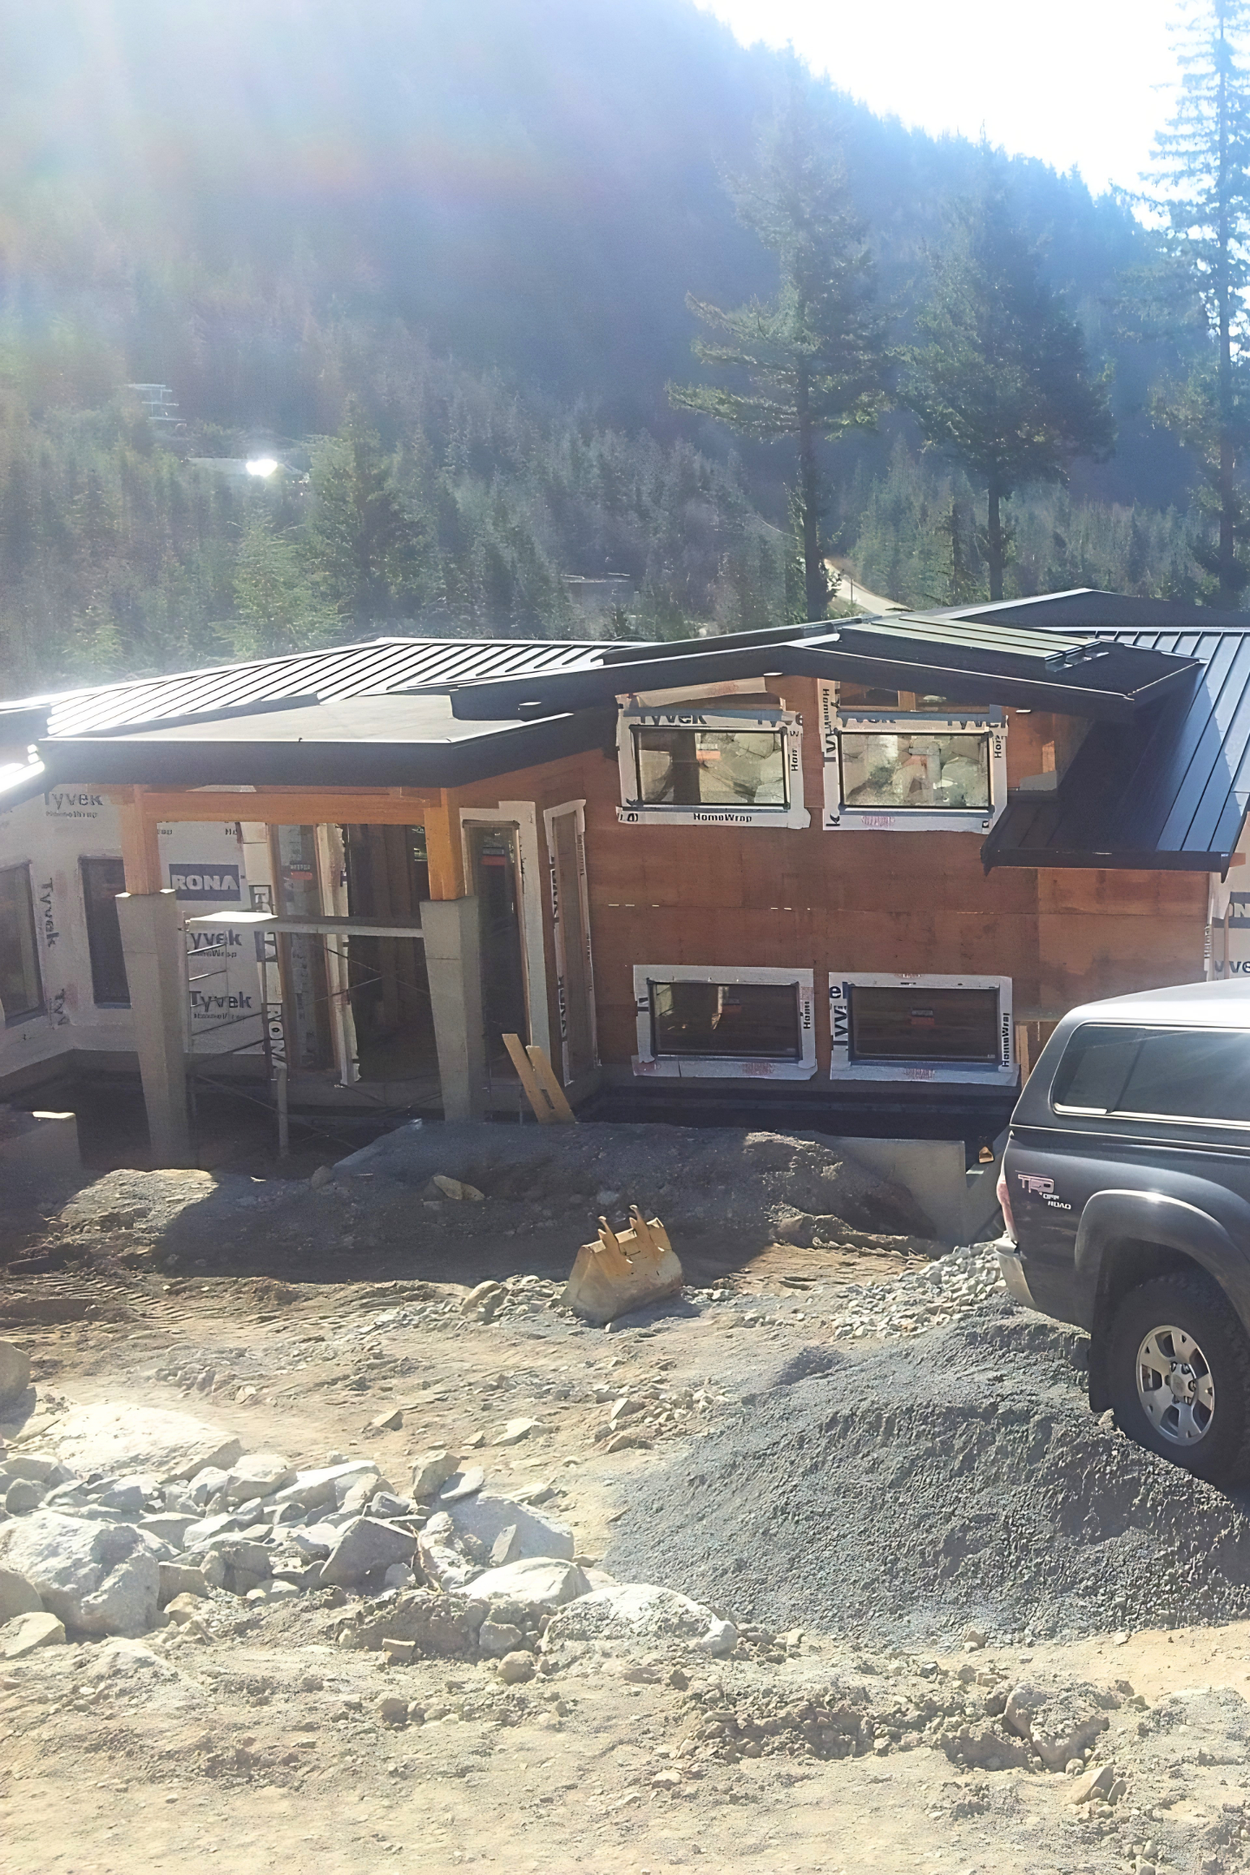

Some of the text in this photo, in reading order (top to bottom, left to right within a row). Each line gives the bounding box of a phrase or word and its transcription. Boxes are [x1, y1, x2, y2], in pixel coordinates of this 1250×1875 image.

[693, 812, 753, 823] HomeWrap
[171, 874, 239, 891] RONA
[189, 991, 252, 1013] Tyvek
[1047, 1200, 1072, 1210] ROAD
